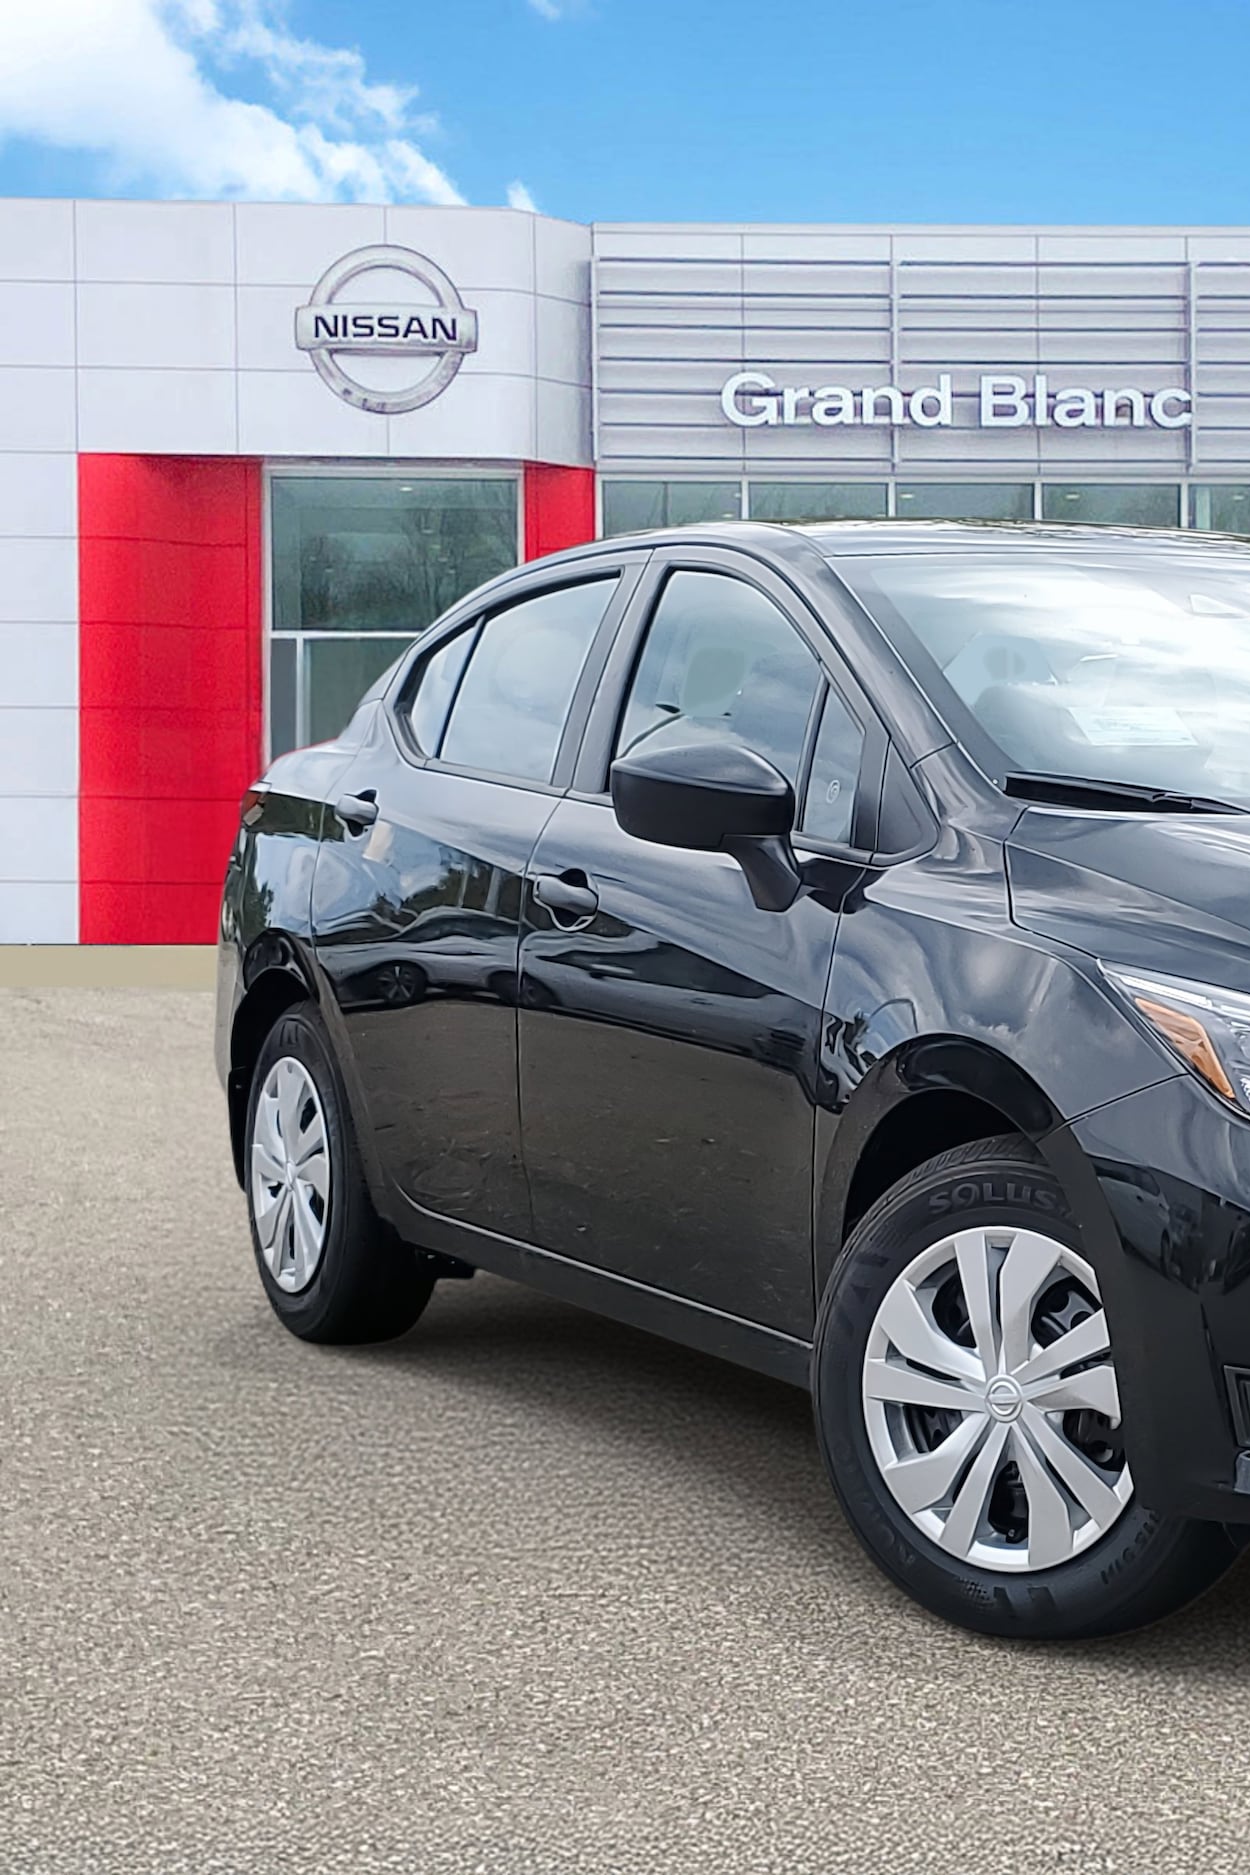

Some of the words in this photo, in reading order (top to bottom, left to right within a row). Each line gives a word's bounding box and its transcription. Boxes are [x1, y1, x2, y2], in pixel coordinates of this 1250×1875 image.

[313, 315, 457, 341] NISSAN
[721, 371, 952, 427] Grand
[979, 374, 1194, 428] Blanc
[928, 1182, 1057, 1214] SOLUS
